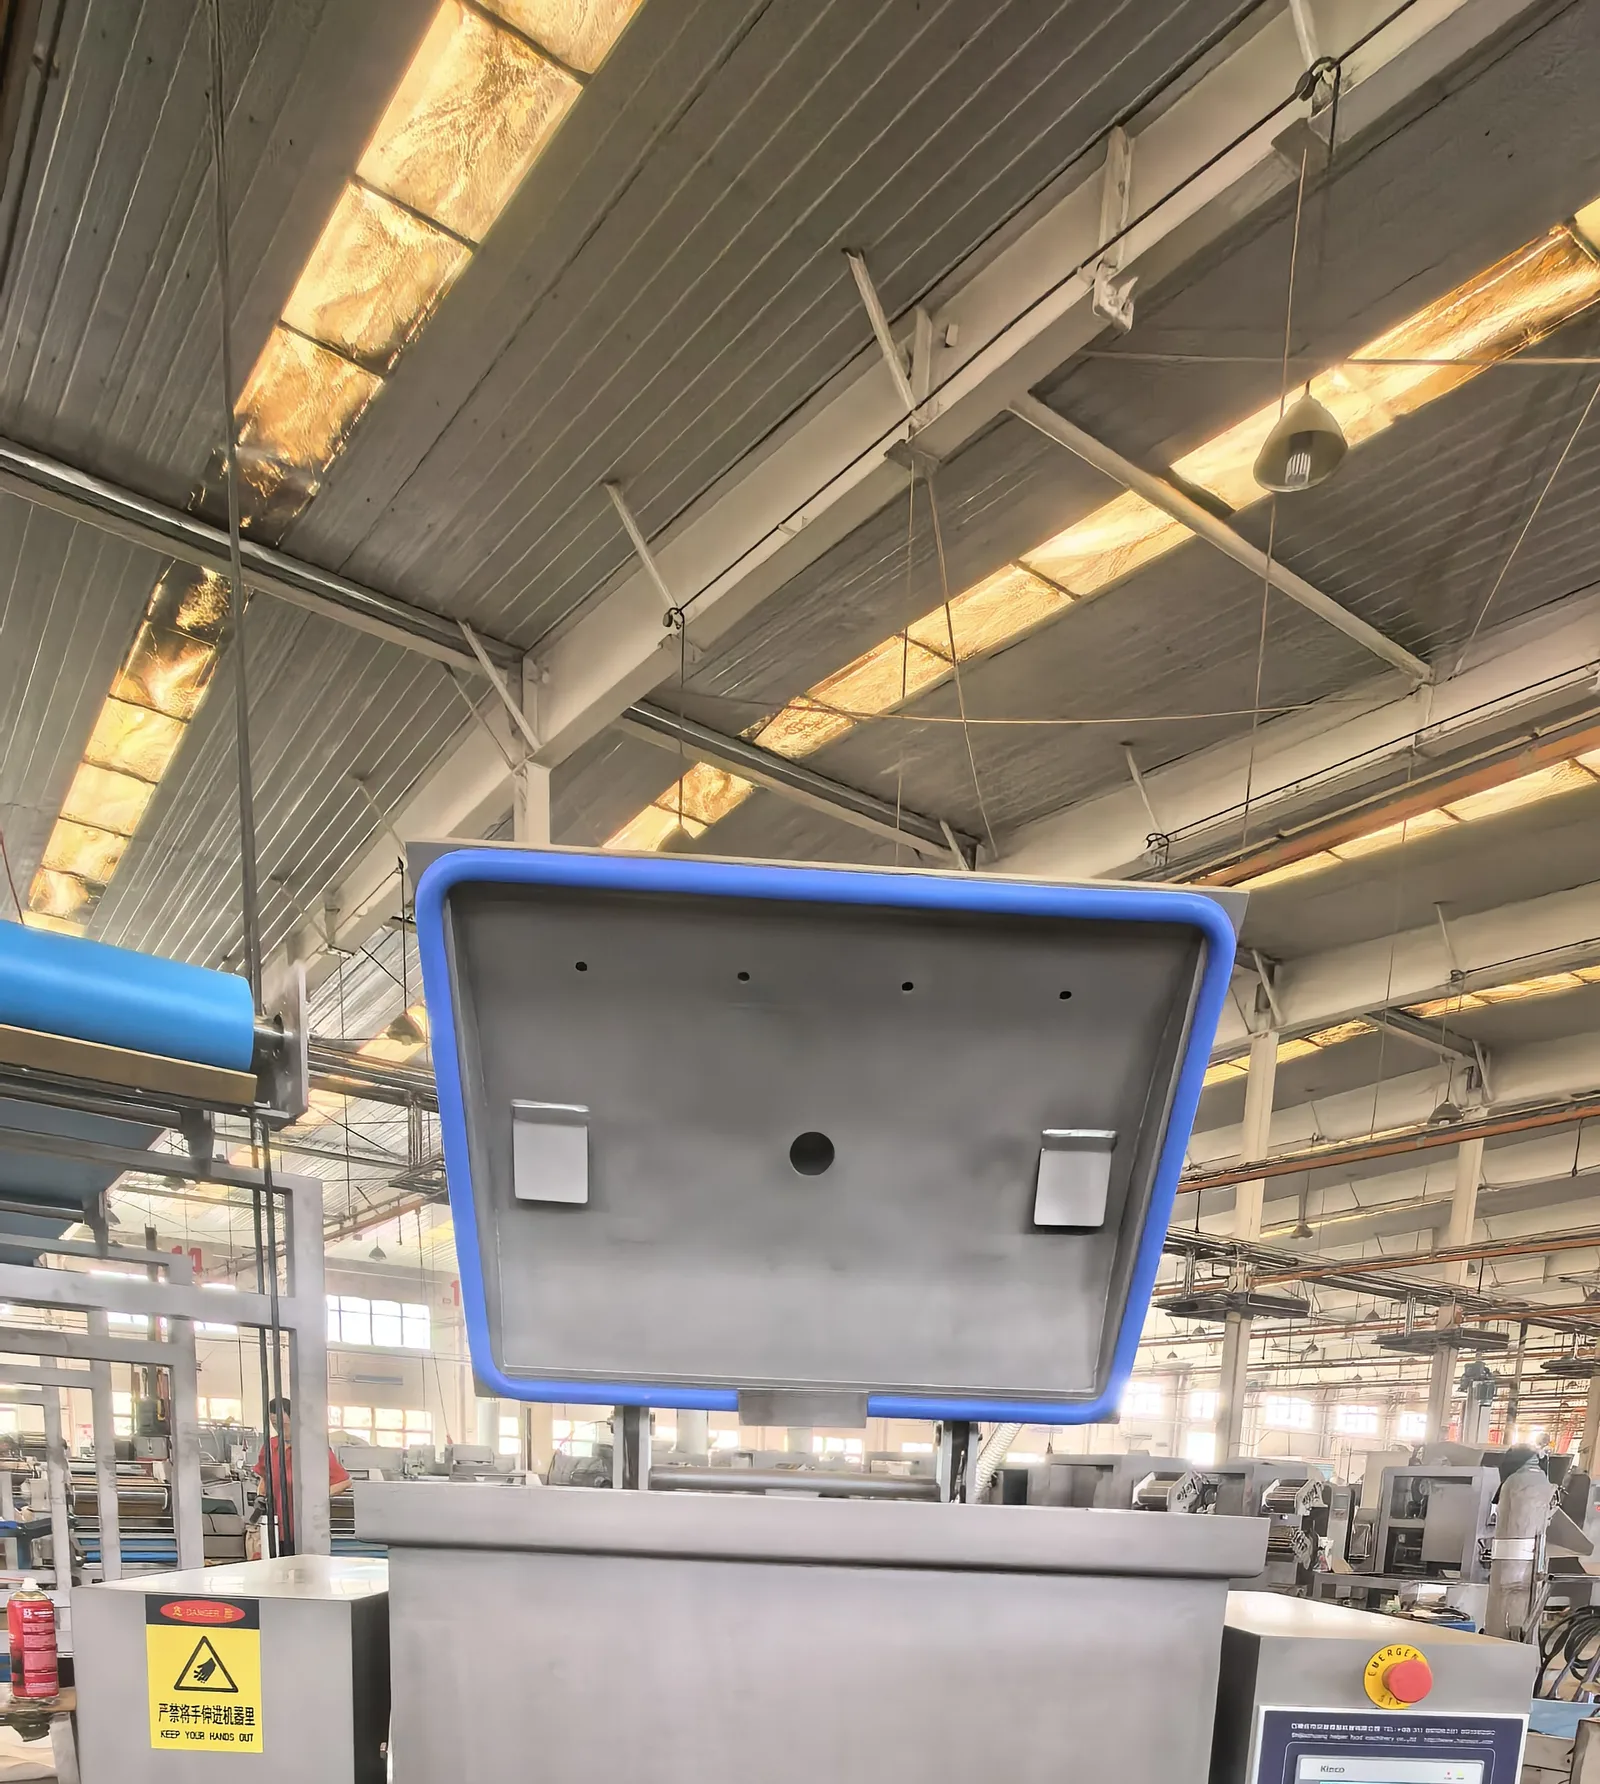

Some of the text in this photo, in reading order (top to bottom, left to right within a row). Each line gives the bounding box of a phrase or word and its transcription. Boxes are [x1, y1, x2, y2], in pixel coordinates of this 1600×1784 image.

[158, 1703, 256, 1726] 严禁将手伸进机器里
[160, 1730, 253, 1742] KEEP YOUR HANDS OUT
